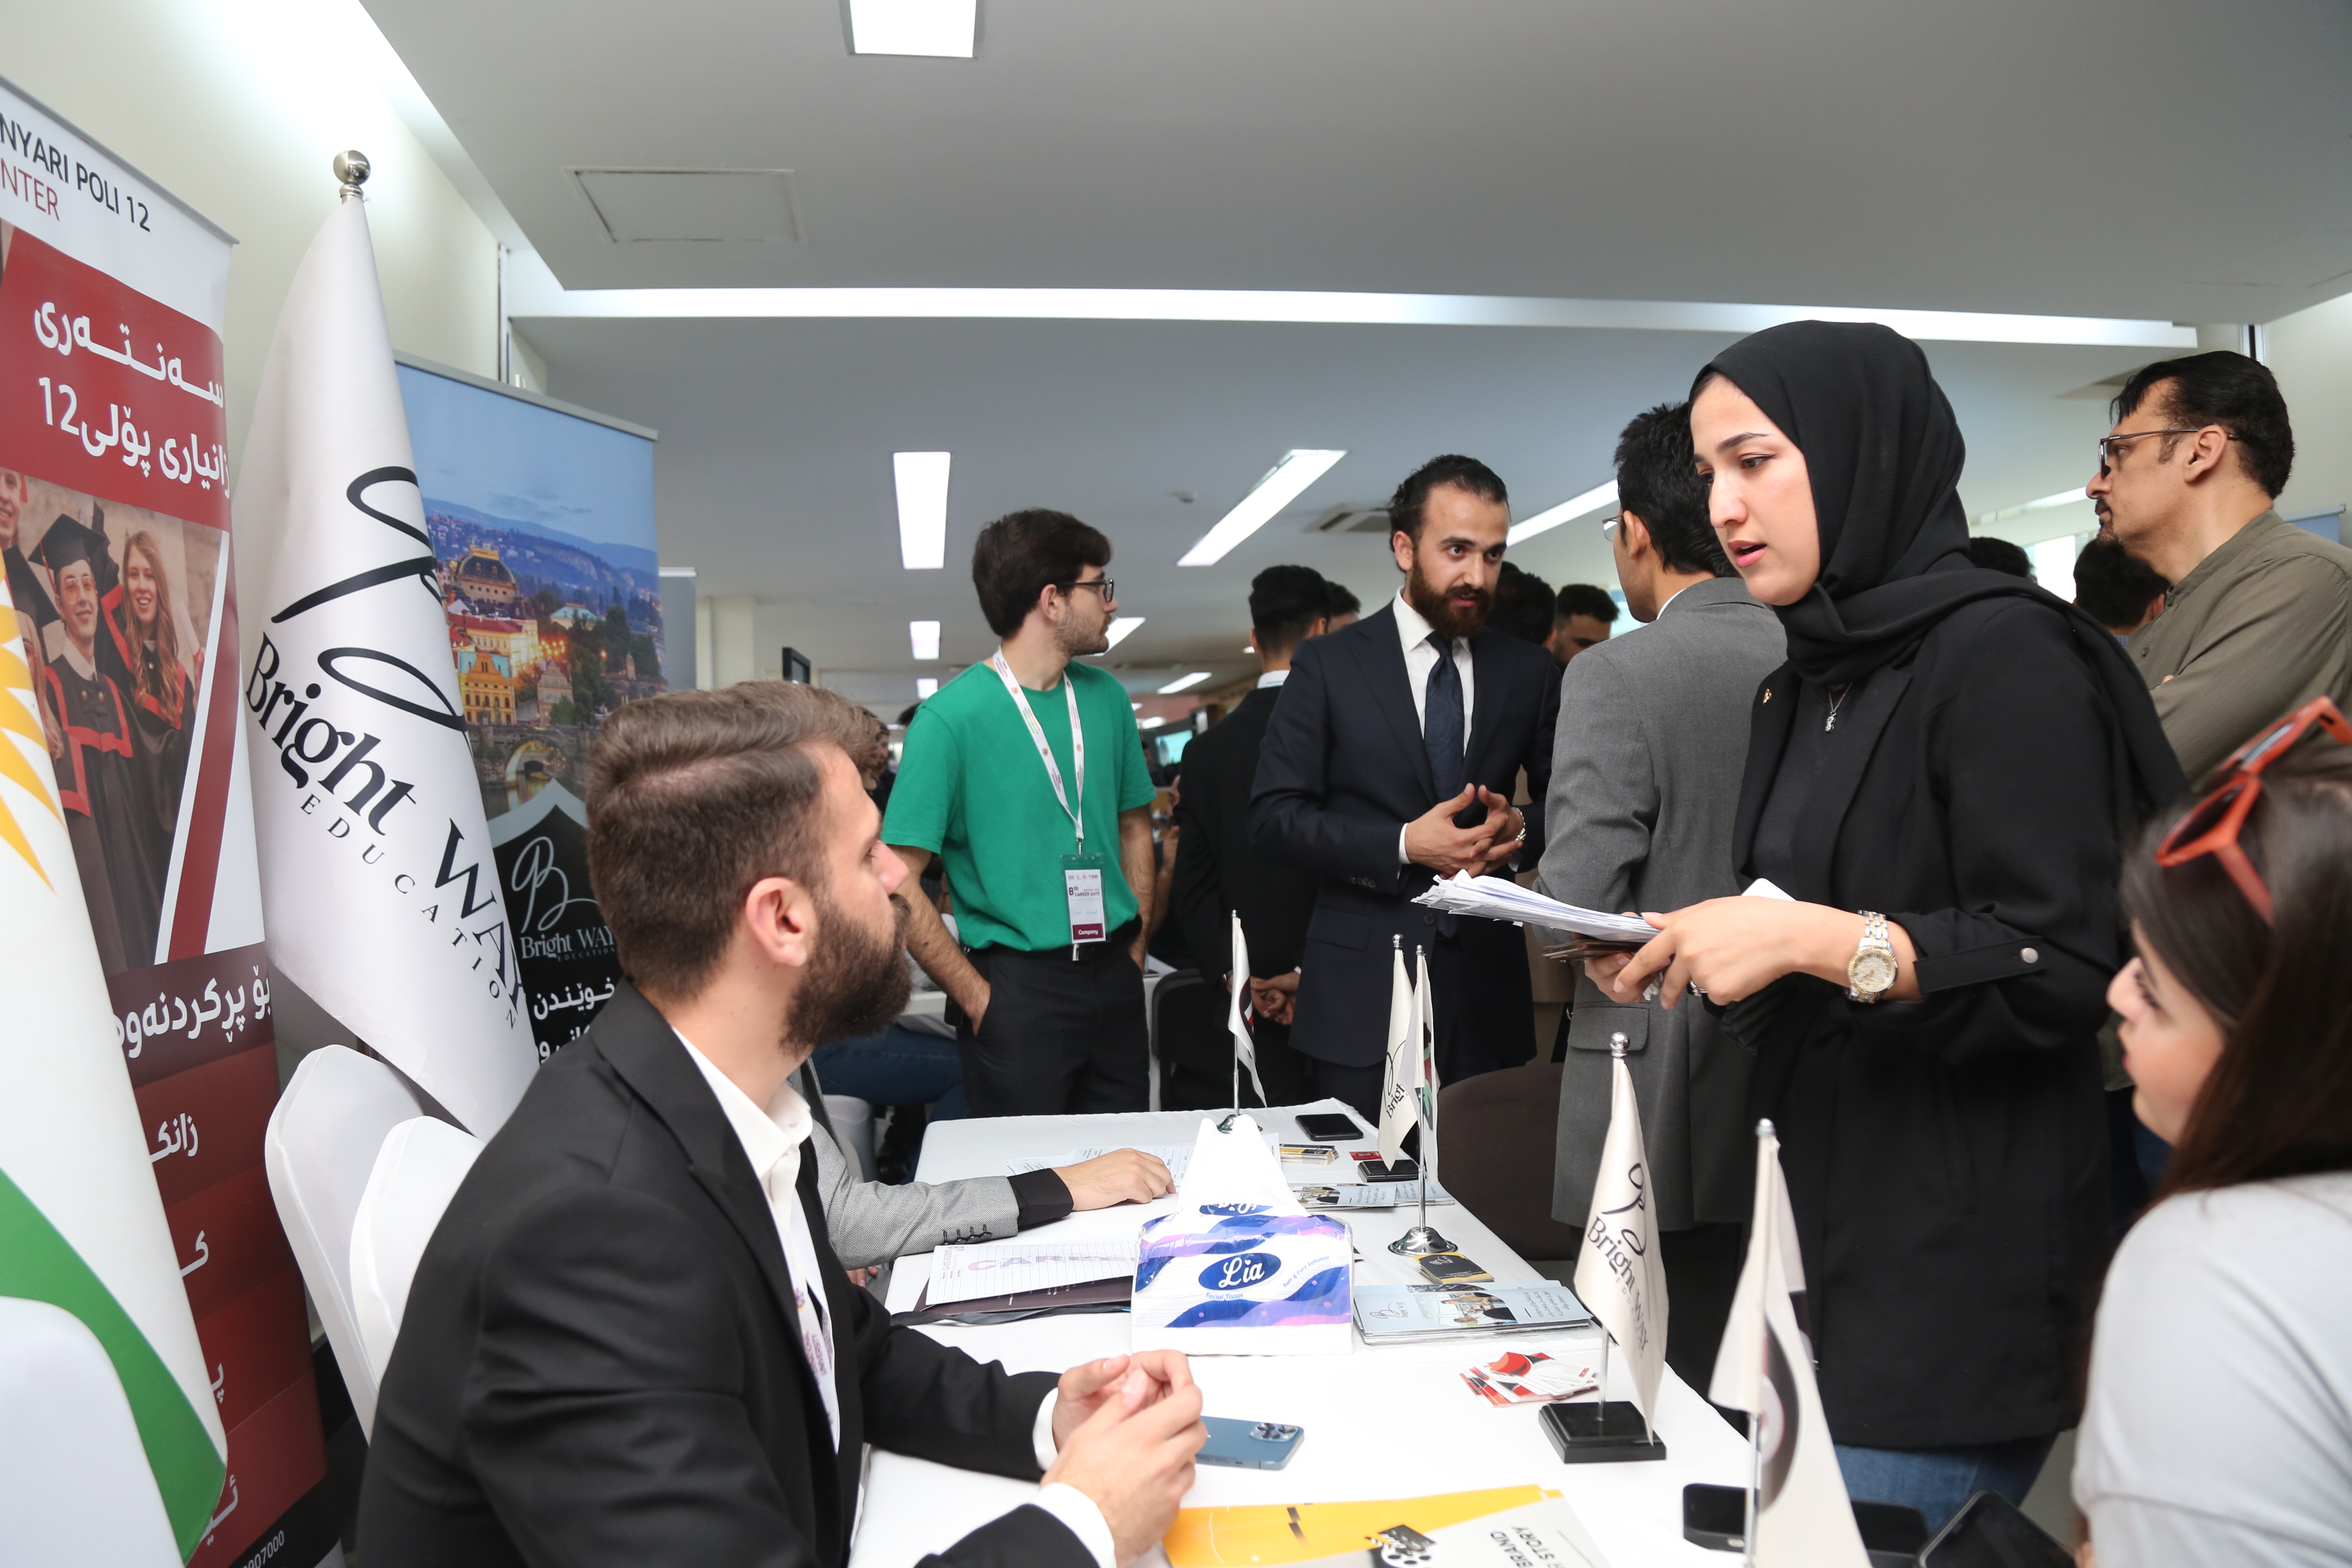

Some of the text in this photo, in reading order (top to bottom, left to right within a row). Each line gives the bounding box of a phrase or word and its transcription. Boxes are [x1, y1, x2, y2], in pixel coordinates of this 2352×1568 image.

[0, 112, 151, 232] NYARI POLI 12
[0, 157, 60, 221] NTER
[246, 631, 524, 1016] Bright WAY
[300, 793, 516, 1030] EDUCATION
[519, 925, 615, 959] Bright WAY
[557, 947, 615, 962] EDUCATION
[1386, 1083, 1406, 1120] Brig
[149, 1113, 199, 1163] زانک
[967, 1255, 1136, 1271] CAREE
[1218, 1257, 1265, 1288] Lia
[1296, 1265, 1308, 1275] Pure
[1308, 1255, 1330, 1266] Cellulose
[1490, 1530, 1535, 1568] BRAND
[1511, 1526, 1555, 1560] STORY
